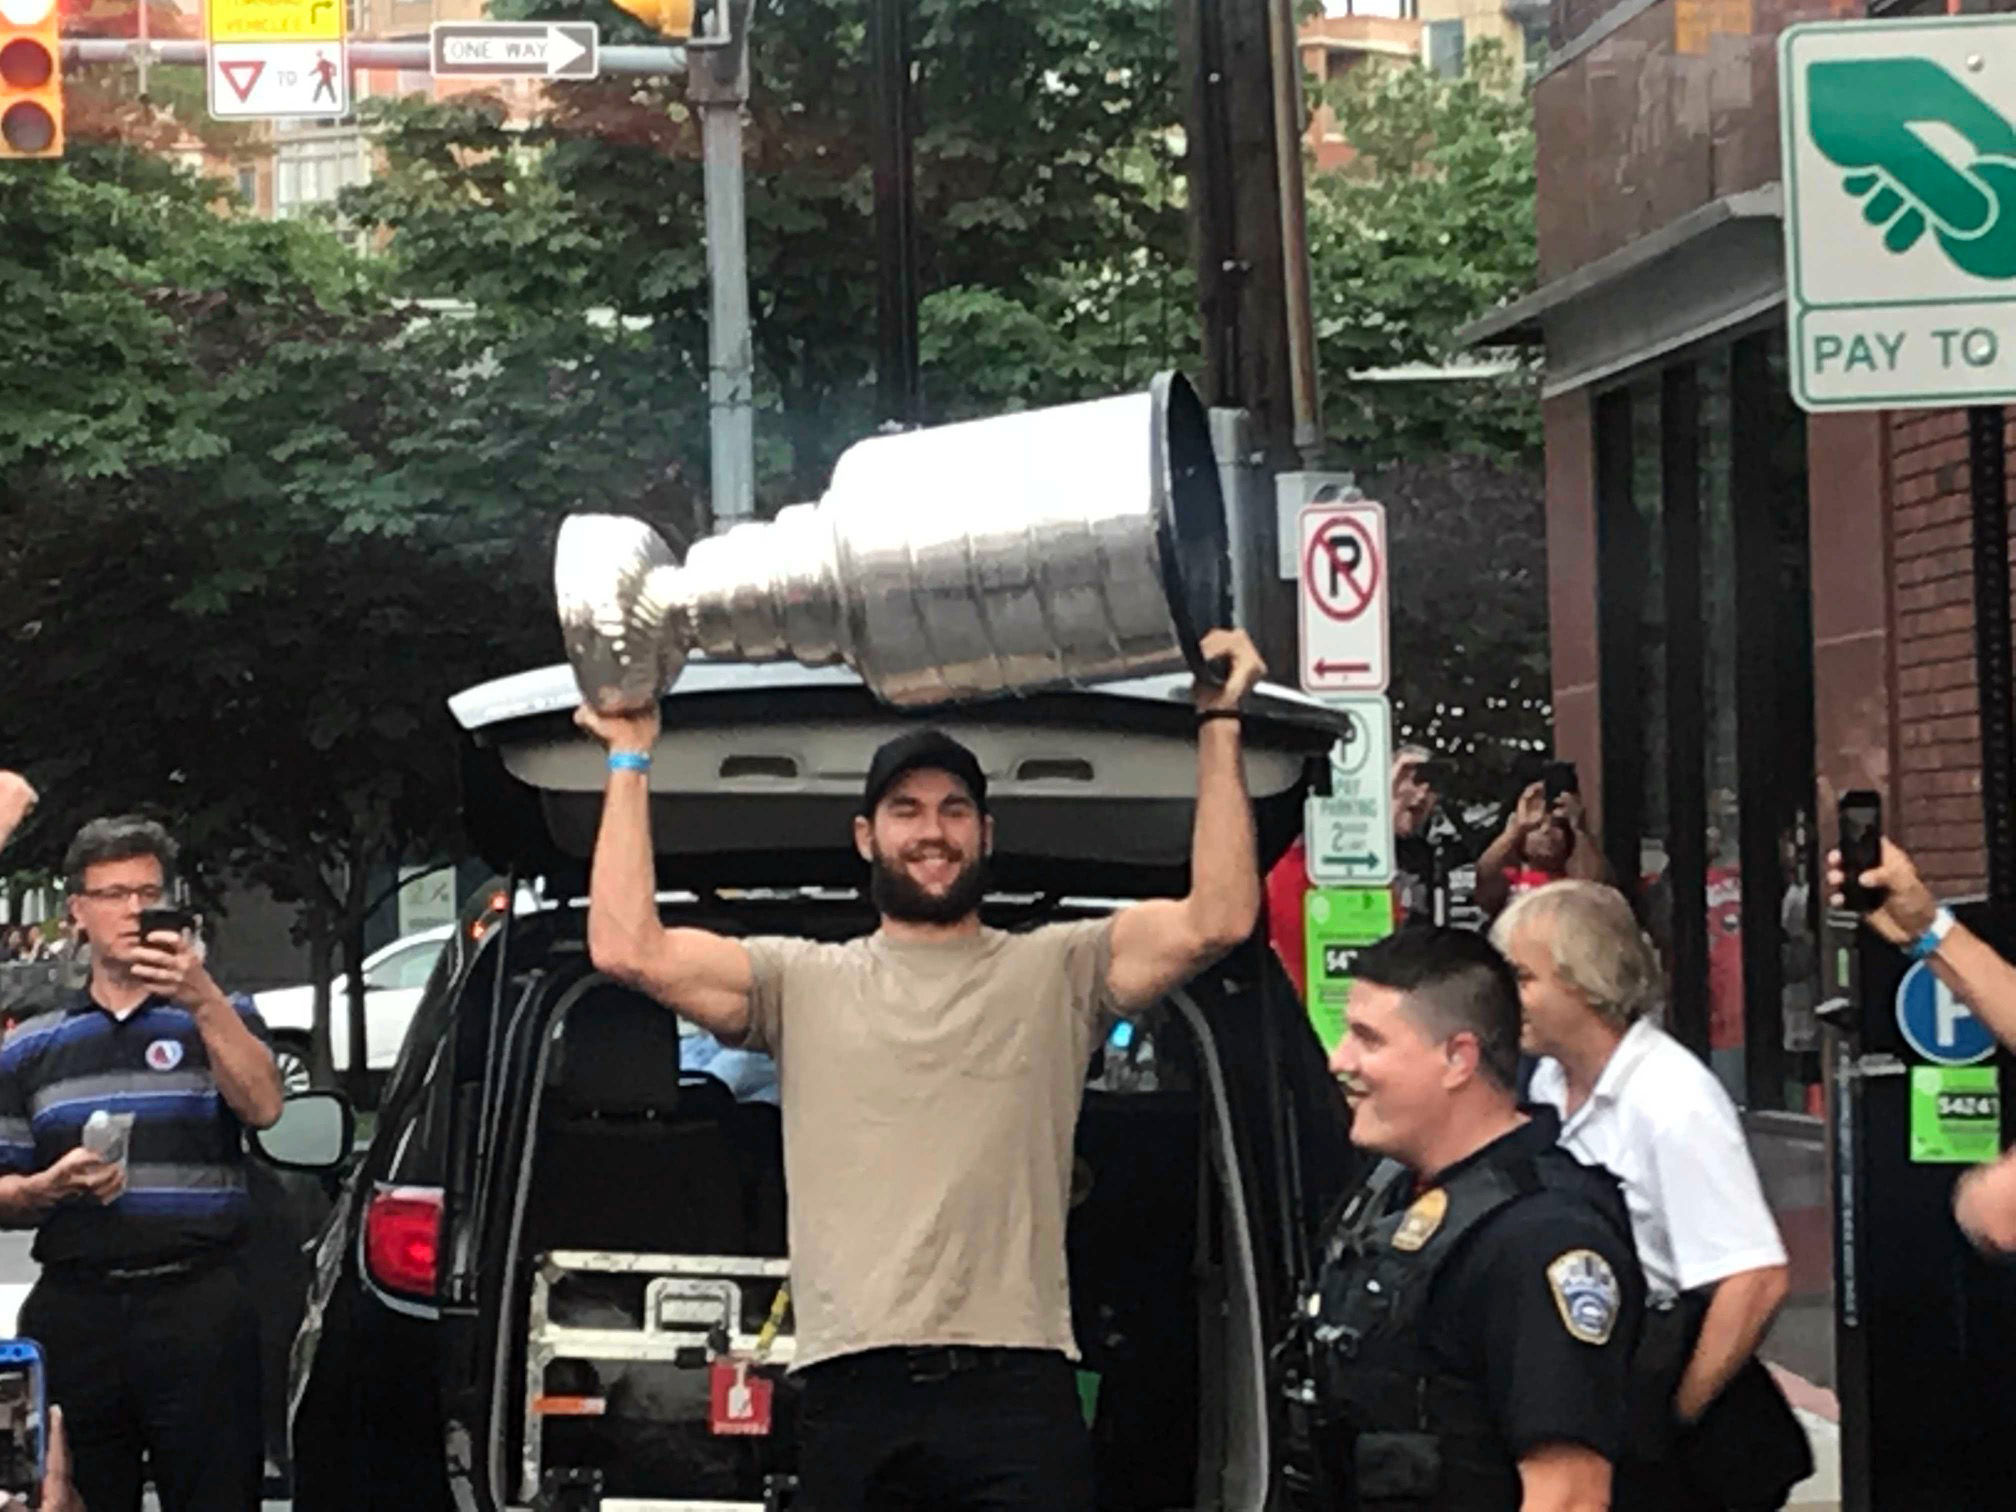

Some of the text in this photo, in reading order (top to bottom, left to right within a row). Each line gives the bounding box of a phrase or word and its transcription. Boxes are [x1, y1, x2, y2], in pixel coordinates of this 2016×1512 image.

[450, 42, 548, 60] ONE WAY
[276, 70, 298, 87] TO
[1813, 327, 1999, 375] PAY TO
